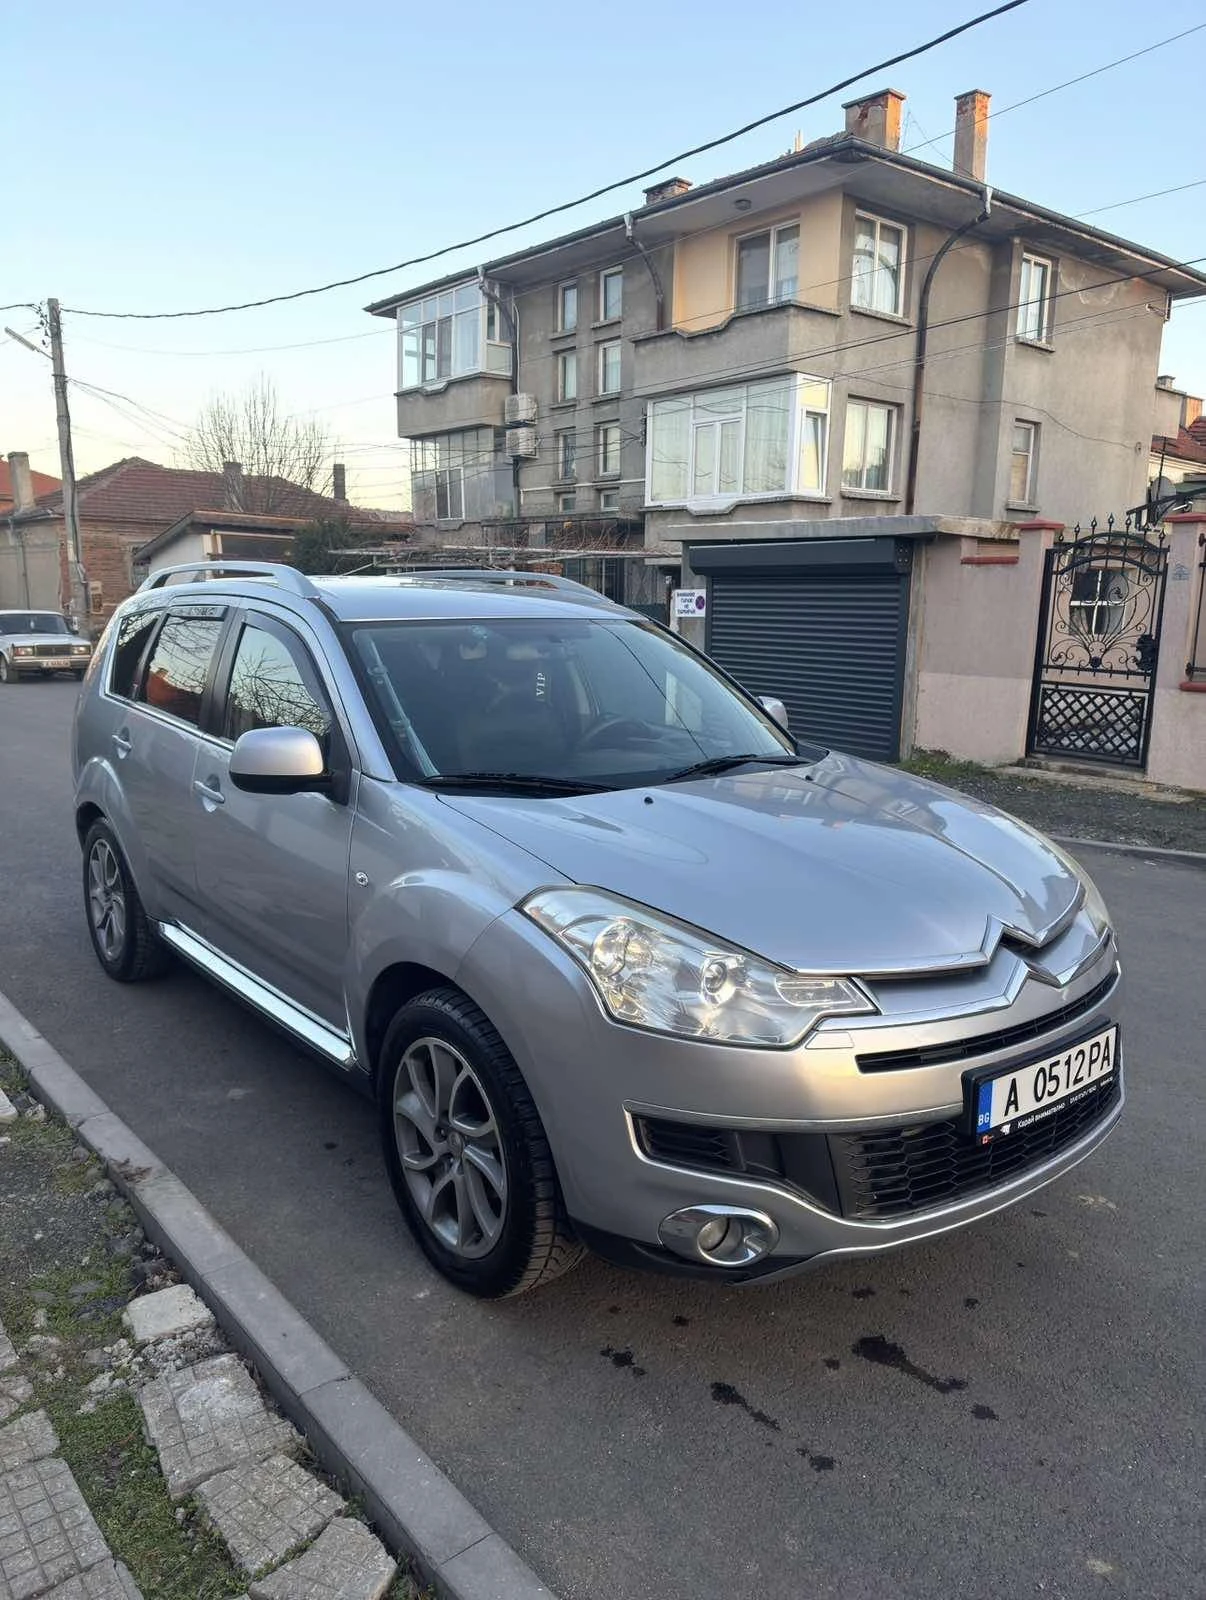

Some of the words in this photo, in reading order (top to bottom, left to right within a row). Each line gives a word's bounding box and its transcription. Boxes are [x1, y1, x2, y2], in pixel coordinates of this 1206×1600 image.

[536, 672, 545, 696] VIP
[1004, 1077, 1019, 1116] A
[978, 1112, 990, 1125] BG
